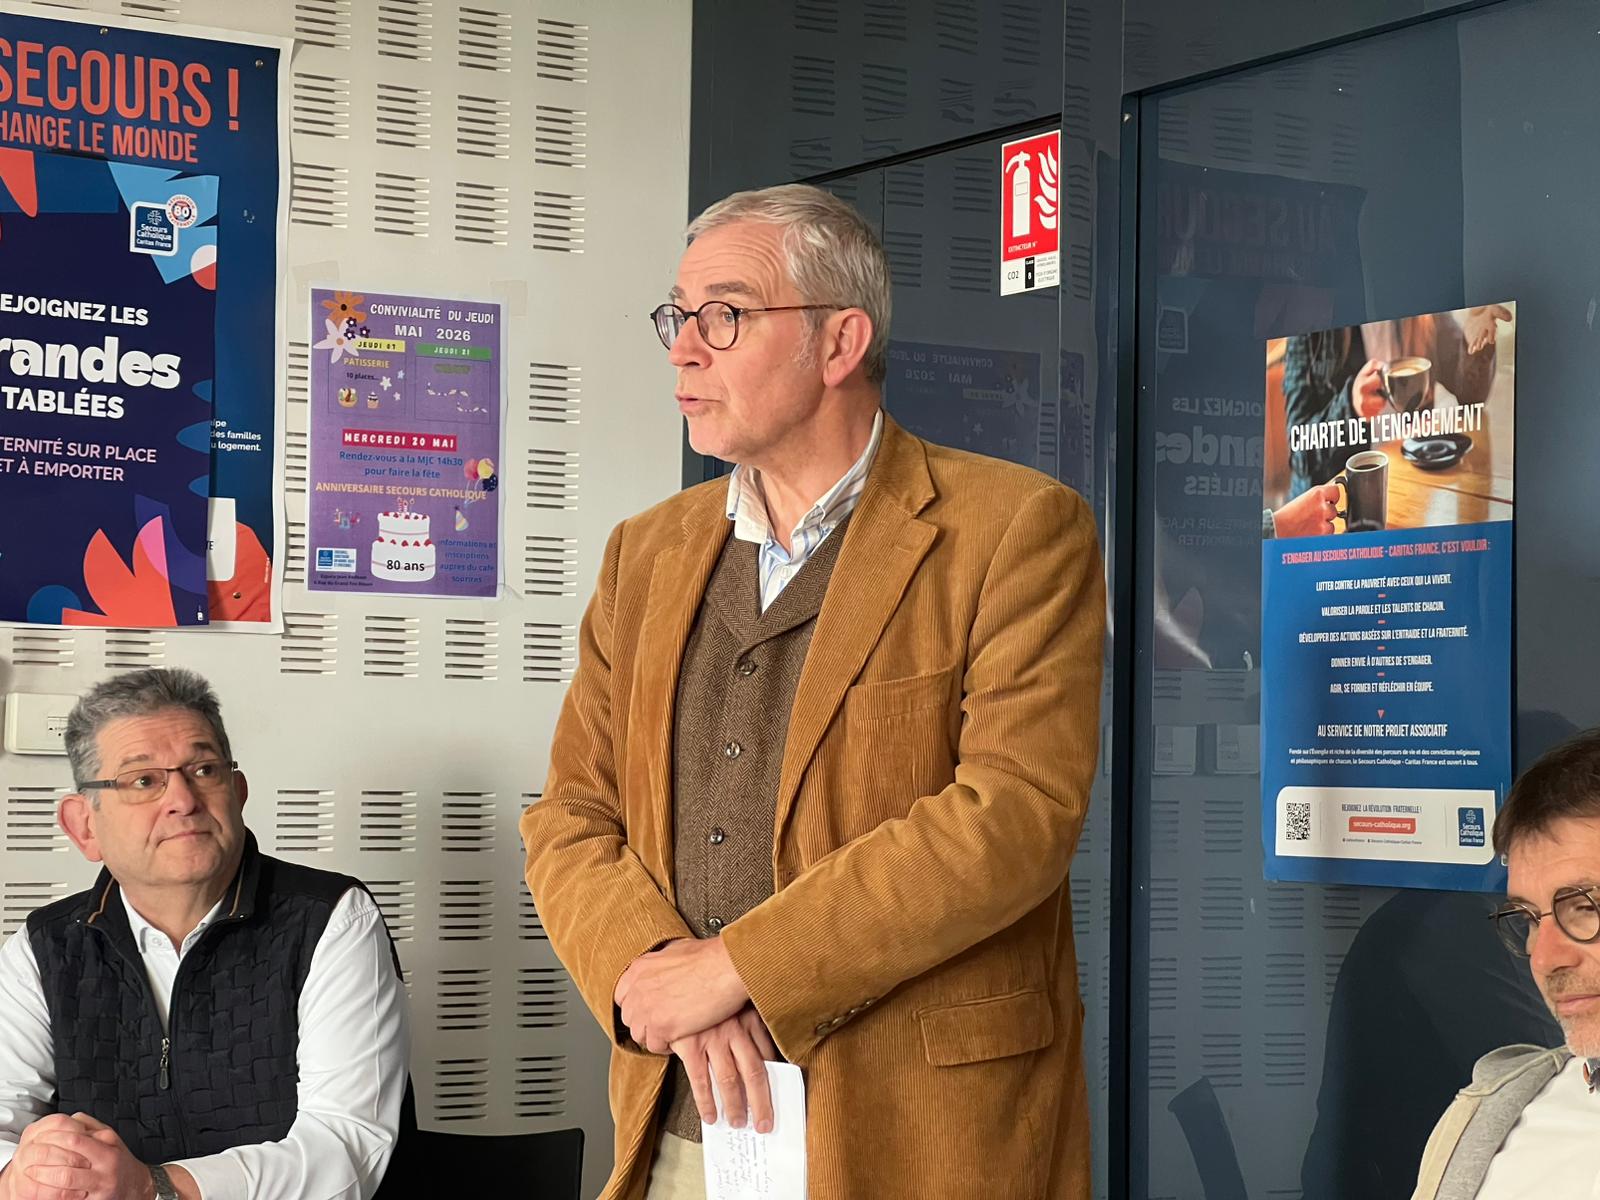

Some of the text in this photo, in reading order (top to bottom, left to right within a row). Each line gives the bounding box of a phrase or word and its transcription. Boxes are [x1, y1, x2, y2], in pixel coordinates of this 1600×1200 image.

[228, 68, 239, 131] !
[79, 120, 105, 153] LE
[112, 125, 198, 163] MONDE
[174, 205, 190, 218] 80
[137, 230, 172, 240] Catholique
[141, 223, 168, 234] Secours
[155, 240, 171, 248] France
[1008, 271, 1018, 280] CO2
[110, 305, 149, 326] LES
[370, 304, 494, 324] CONVIVIALITÉ DU JEUDI
[395, 325, 471, 342] MAI 2026
[358, 341, 382, 349] JEUDI
[434, 346, 458, 355] JEUDI
[1, 386, 124, 419] TABLÉES
[1290, 403, 1484, 452] CHARTE DE L'ENGAGEMENT
[227, 430, 262, 441] familles
[344, 433, 454, 449] MERCREDI 20 MAI
[0, 436, 157, 463] ERNITÉ SUR PLACE
[218, 440, 262, 451] logement.
[339, 451, 463, 466] Rendez-vous la MJC 14h30
[17, 456, 29, 474] À
[34, 461, 124, 481] EMPORTER
[365, 467, 440, 479] pour faire la fête
[315, 482, 487, 500] ANNIVERSAIRE SECOURS CATHOLIQUE
[1282, 552, 1313, 565] S'ENGAGER
[1313, 551, 1321, 563] AU
[1322, 549, 1347, 561] SECOURS
[1348, 546, 1384, 559] CATHOLIQUE
[1388, 544, 1414, 557] CARITAS
[1441, 541, 1459, 553] C'EST
[386, 560, 425, 571] 80 ans
[1316, 573, 1452, 592] LUTTER CONTRE LA PAUVRETÉ AVEC CEUX QUI LA VIVENT.
[1321, 606, 1347, 616] VALORISER
[1348, 605, 1355, 615] LA
[1355, 604, 1374, 615] PAROLE
[1375, 604, 1381, 614] ET
[1381, 603, 1391, 614] LES
[1392, 602, 1413, 613] TALENTS
[1415, 602, 1421, 612] DE
[1299, 631, 1329, 643] DÉVELOPPER
[1330, 632, 1339, 641] DES
[1340, 631, 1361, 641] ACTIONS
[1361, 628, 1380, 641] BASÉES
[1381, 630, 1391, 640] SUR
[1392, 628, 1421, 639] L'ENTRAIDE
[1421, 628, 1427, 638] ET
[1428, 628, 1435, 638] LA
[1330, 657, 1351, 668] DONNER
[1351, 657, 1366, 667] ENVIE
[1367, 655, 1371, 666] À
[1372, 656, 1395, 666] D'AUTRES
[1396, 656, 1403, 666] DE
[1344, 683, 1350, 693] SE
[1351, 683, 1371, 693] FORMER
[1371, 682, 1378, 692] ET
[1378, 681, 1406, 692] RÉFLÉCHIR
[1406, 682, 1413, 692] EN
[1317, 724, 1448, 737] AU SERVICE DE NOTRE PROJET ASSOCIATIF
[1363, 804, 1368, 812] LA
[1353, 821, 1411, 831] secours-catholique.org
[1460, 829, 1483, 837] Catholique
